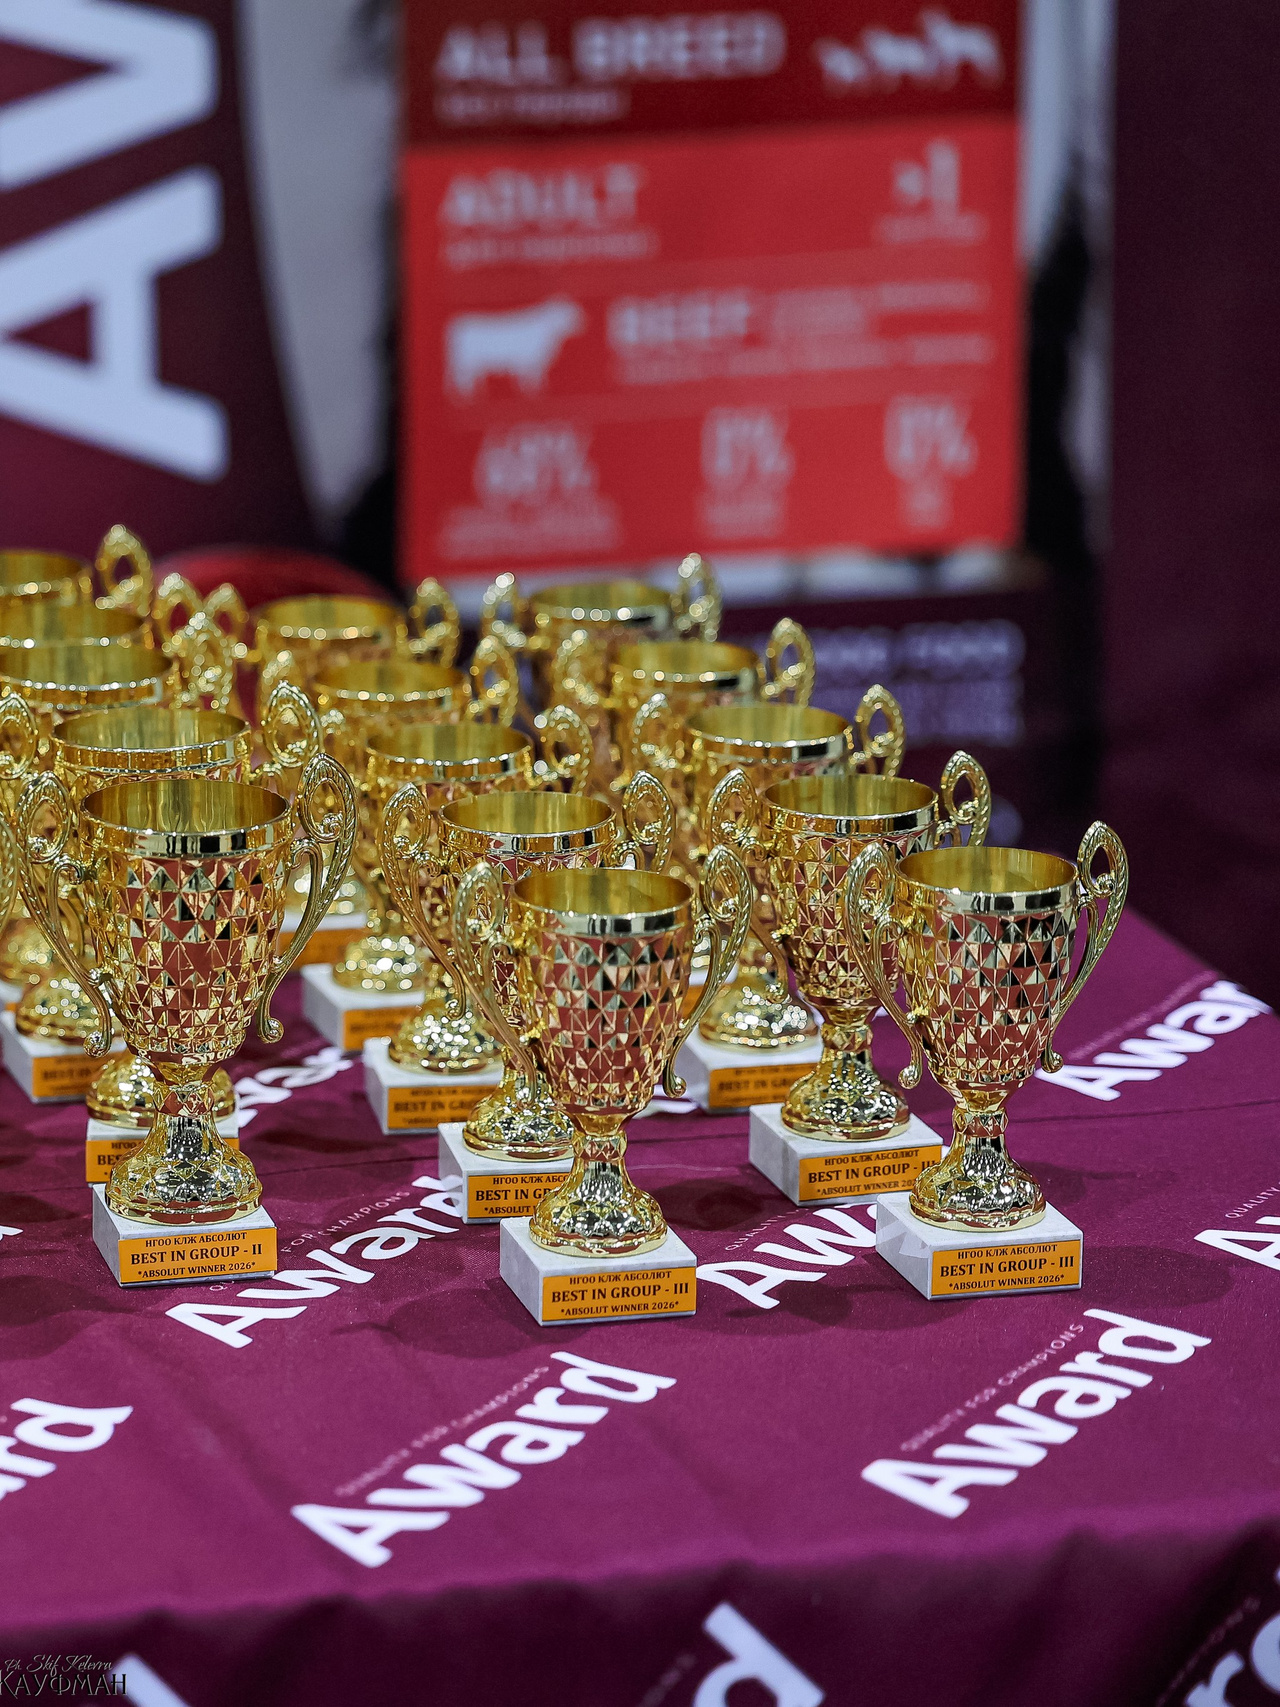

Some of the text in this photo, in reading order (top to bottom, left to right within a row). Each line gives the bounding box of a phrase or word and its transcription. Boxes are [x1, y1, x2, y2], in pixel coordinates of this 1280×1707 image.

[438, 15, 786, 84] ALL BREED
[441, 165, 644, 230] ADULT
[608, 290, 754, 350] BEEF
[1035, 980, 1272, 1101] Awar
[97, 1154, 123, 1165] BES
[874, 1149, 919, 1161] АБСОЛЮТ
[493, 1173, 569, 1185] НГОО КЛЖ АБСО
[808, 1170, 842, 1183] BEST
[845, 1168, 860, 1180] IN
[863, 1163, 910, 1178] GROUP
[476, 1189, 510, 1201] BEST
[515, 1188, 528, 1200] IN
[864, 1181, 899, 1191] WINNER
[1225, 1186, 1280, 1219] QUALITY
[145, 1232, 247, 1247] НГОО КЛЖ АБСОЛЮТ
[131, 1251, 166, 1265] BEST
[171, 1250, 186, 1262] IN
[190, 1246, 240, 1260] GROUP
[252, 1243, 262, 1255] II
[957, 1244, 1057, 1260] НГОО КЛЖ АБСОЛЮТ
[187, 1265, 226, 1275] WINNER
[940, 1264, 975, 1277] BEST
[979, 1262, 994, 1275] IN
[998, 1258, 1047, 1273] GROUP
[1059, 1256, 1074, 1268] III
[570, 1271, 672, 1285] НГОО КЛЖ АБСОЛЮТ
[998, 1277, 1036, 1286] WINNER
[552, 1290, 588, 1303] BEST
[592, 1288, 607, 1300] IN
[610, 1284, 661, 1298] GROUP
[674, 1282, 689, 1295] III
[611, 1303, 649, 1313] WINNER
[861, 1308, 1212, 1519] Award
[290, 1351, 677, 1569] Award
